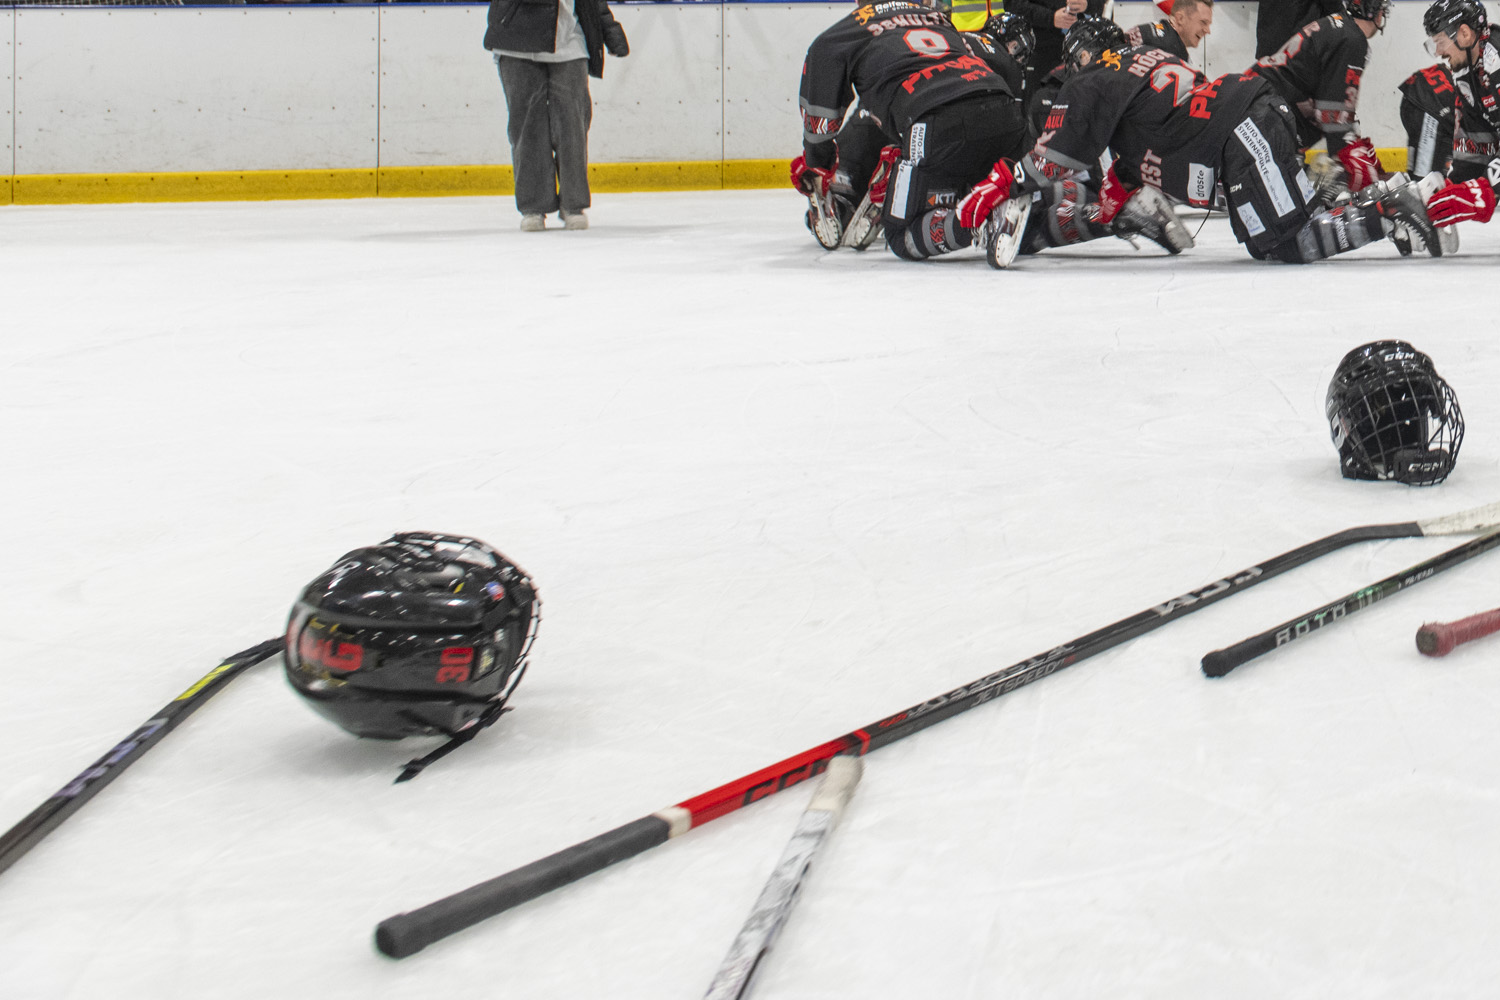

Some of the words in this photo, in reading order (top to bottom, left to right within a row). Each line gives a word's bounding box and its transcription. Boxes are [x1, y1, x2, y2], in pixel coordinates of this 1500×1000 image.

[1237, 126, 1269, 176] STRATENSCULTE
[1243, 121, 1272, 164] AUTO-SERVICE
[1195, 169, 1205, 198] droste
[1384, 352, 1415, 362] CCM
[971, 663, 1057, 707] JETSPEED
